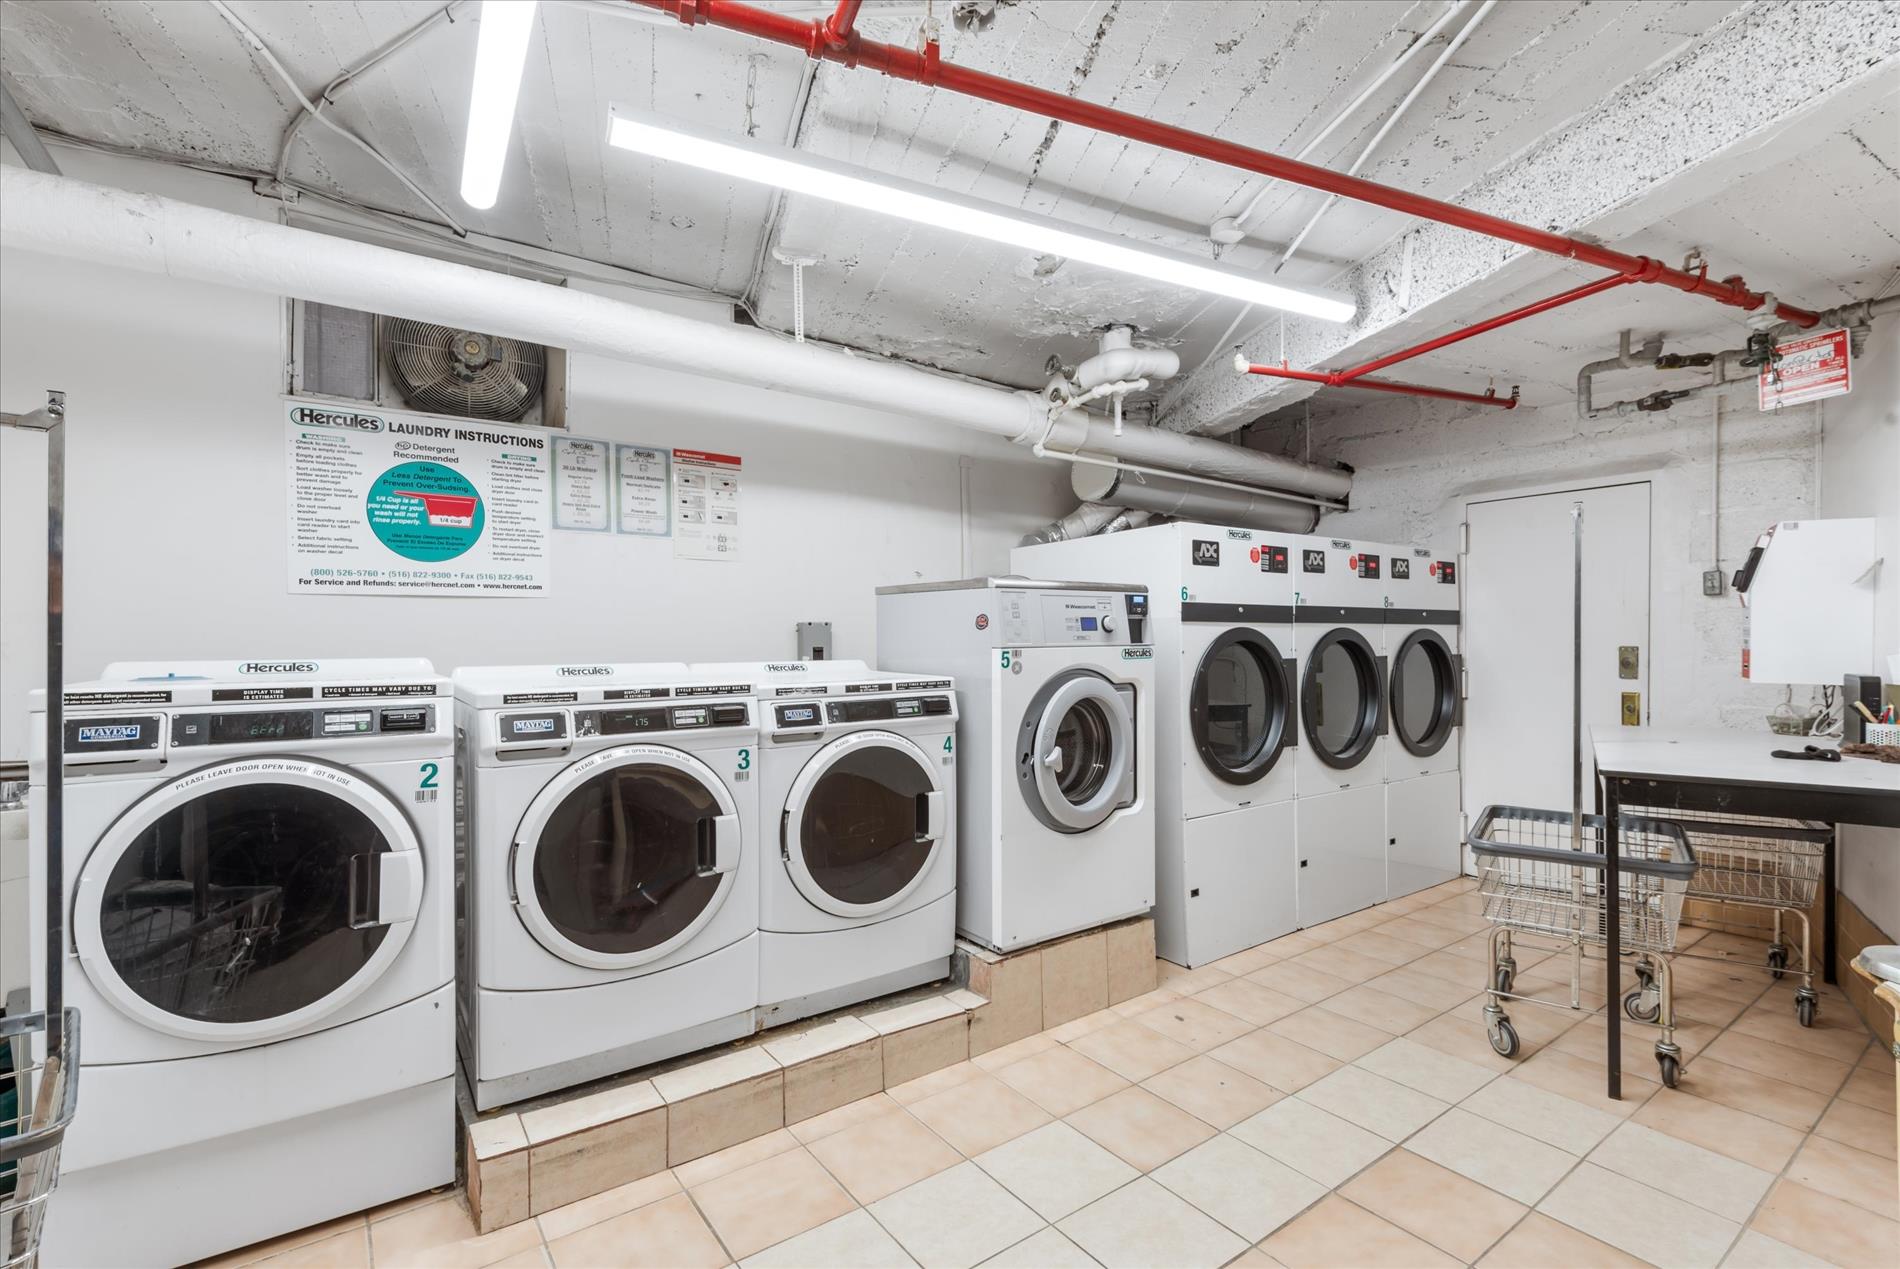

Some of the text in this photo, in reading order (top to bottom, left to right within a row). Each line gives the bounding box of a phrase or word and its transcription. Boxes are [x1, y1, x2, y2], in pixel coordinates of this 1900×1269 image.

[1810, 335, 1844, 348] SPRINKLERS
[1782, 361, 1821, 376] OPEN
[299, 408, 544, 449] Hercules LAUNDRY INSTRUCTIONS
[413, 443, 455, 454] Detergent
[393, 451, 459, 464] Recommended
[413, 474, 451, 483] Detergent
[383, 479, 469, 493] Prevent Over-Sudsing
[387, 496, 402, 504] Cup
[391, 517, 421, 525] properly.
[1228, 529, 1251, 540] Hercules
[1200, 543, 1217, 558] ADC
[310, 568, 334, 577] (800)
[336, 569, 379, 577] 526-5760
[388, 570, 411, 579] (516)
[412, 571, 451, 579] 822-9300
[476, 573, 496, 581] (516)
[314, 578, 344, 586] Service
[1181, 586, 1188, 601] 6
[1294, 592, 1300, 605] 7
[1384, 596, 1388, 608] 8
[1001, 650, 1010, 669] 5
[1124, 648, 1152, 658] Hercules
[246, 662, 314, 673] Hercules
[561, 667, 610, 676] Hercules
[768, 664, 805, 672] Hercules
[515, 720, 552, 729] MAYTAG
[82, 727, 136, 737] MAYTAG
[943, 735, 953, 753] 4
[737, 749, 750, 770] 3
[574, 760, 595, 774] PLEASE
[175, 776, 205, 791] PLEASE
[207, 767, 232, 779] LEAVE
[235, 764, 260, 772] DOOR
[327, 772, 335, 781] IN
[336, 775, 351, 786] USE
[420, 763, 438, 788] 2
